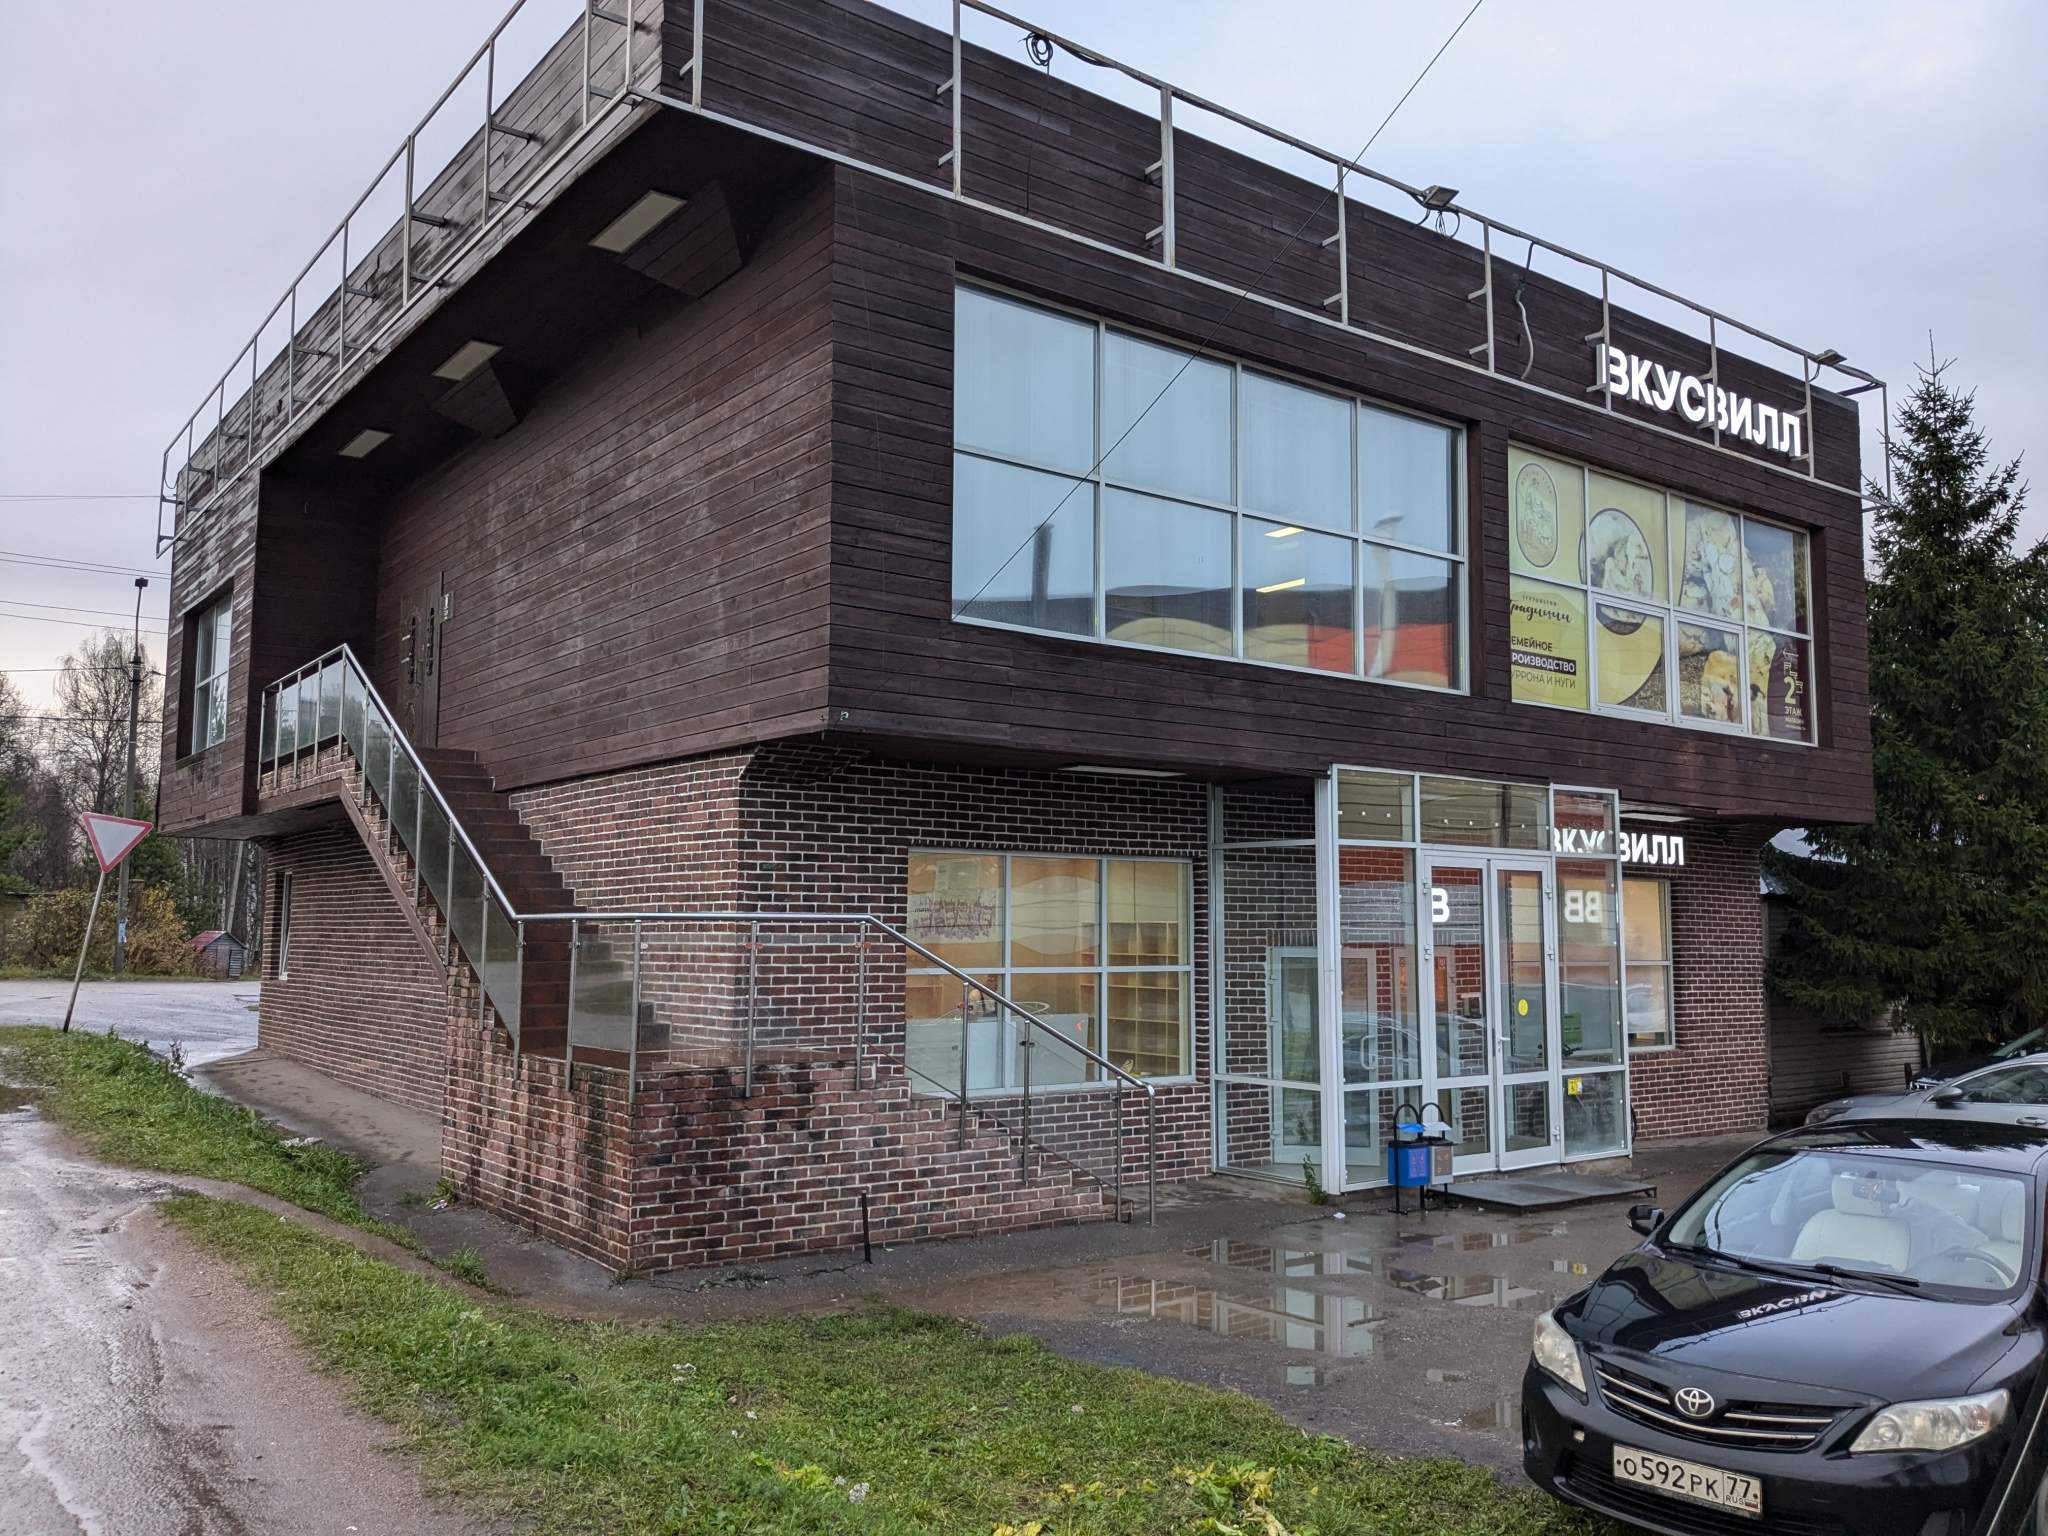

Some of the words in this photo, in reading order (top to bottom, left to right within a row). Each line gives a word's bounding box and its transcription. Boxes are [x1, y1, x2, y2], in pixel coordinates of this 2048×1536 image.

[1597, 343, 1801, 457] ВКУСВИЛЛ
[1511, 636, 1553, 652] ЕМЕЙНОЕ
[1511, 652, 1575, 673] РОИЗВОДСТВО
[1783, 676, 1797, 705] 2
[1725, 1494, 1745, 1506] RUS
